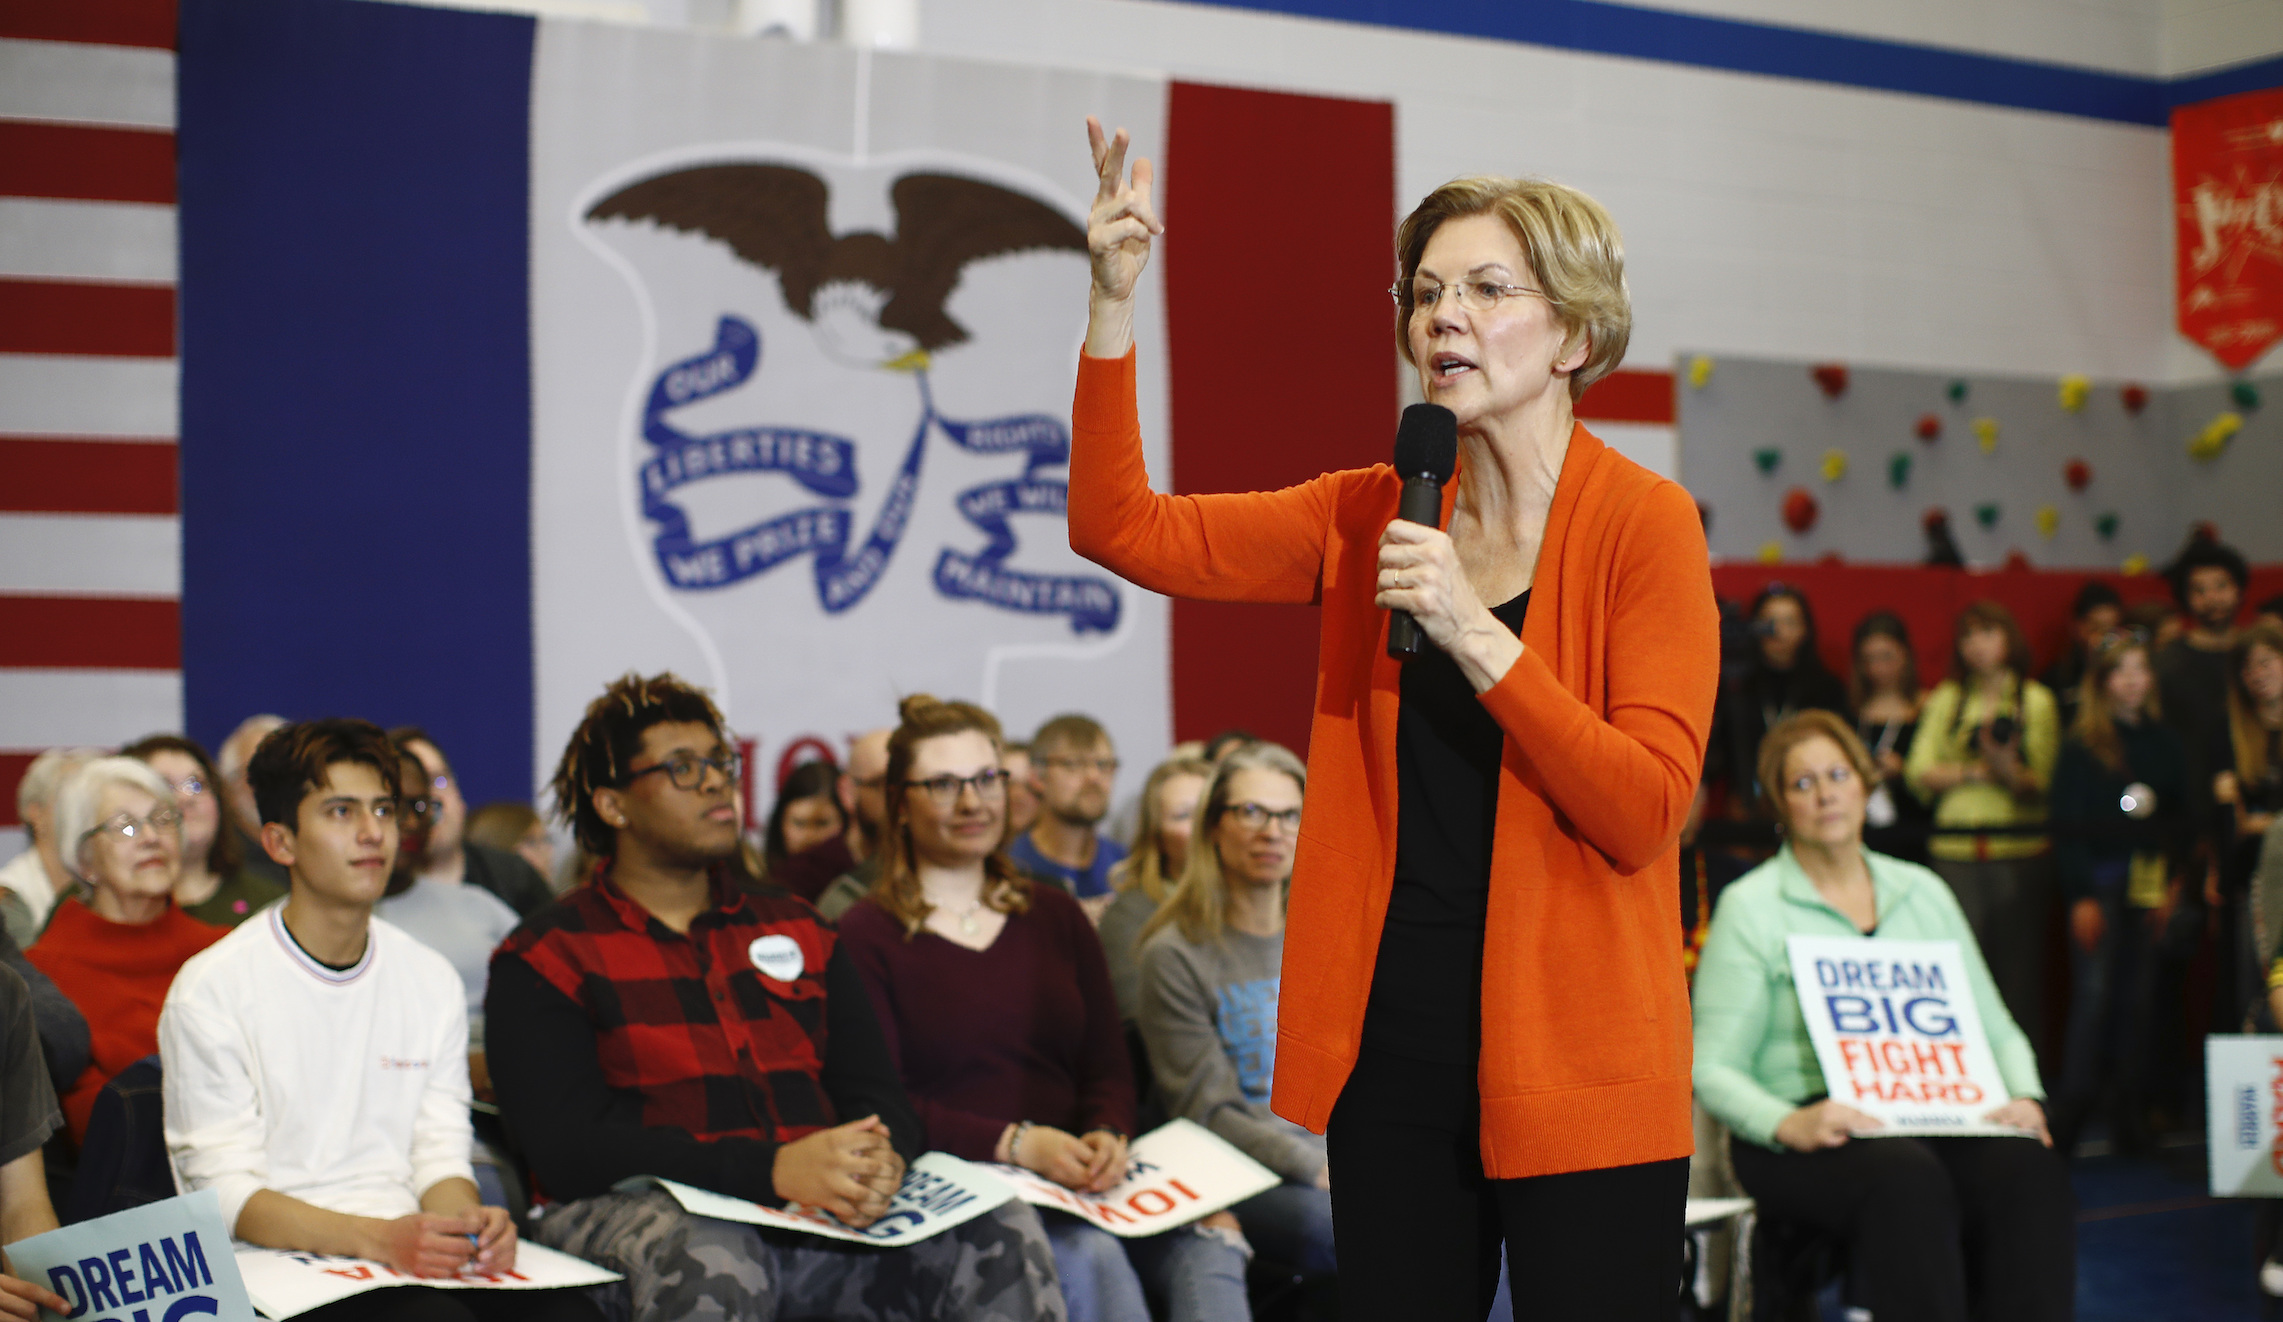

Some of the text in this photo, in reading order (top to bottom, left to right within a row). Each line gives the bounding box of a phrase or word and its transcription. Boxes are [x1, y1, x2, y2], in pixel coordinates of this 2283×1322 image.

[666, 352, 737, 402] OUR
[647, 432, 842, 493] LIBERTIES
[668, 511, 838, 586] WE PRIZE
[1815, 958, 1947, 991] DREAM
[1825, 995, 1962, 1037] BIG
[1838, 1039, 1966, 1077] FIGHT
[1850, 1079, 1984, 1105] HARD
[47, 1230, 214, 1319] DREAM
